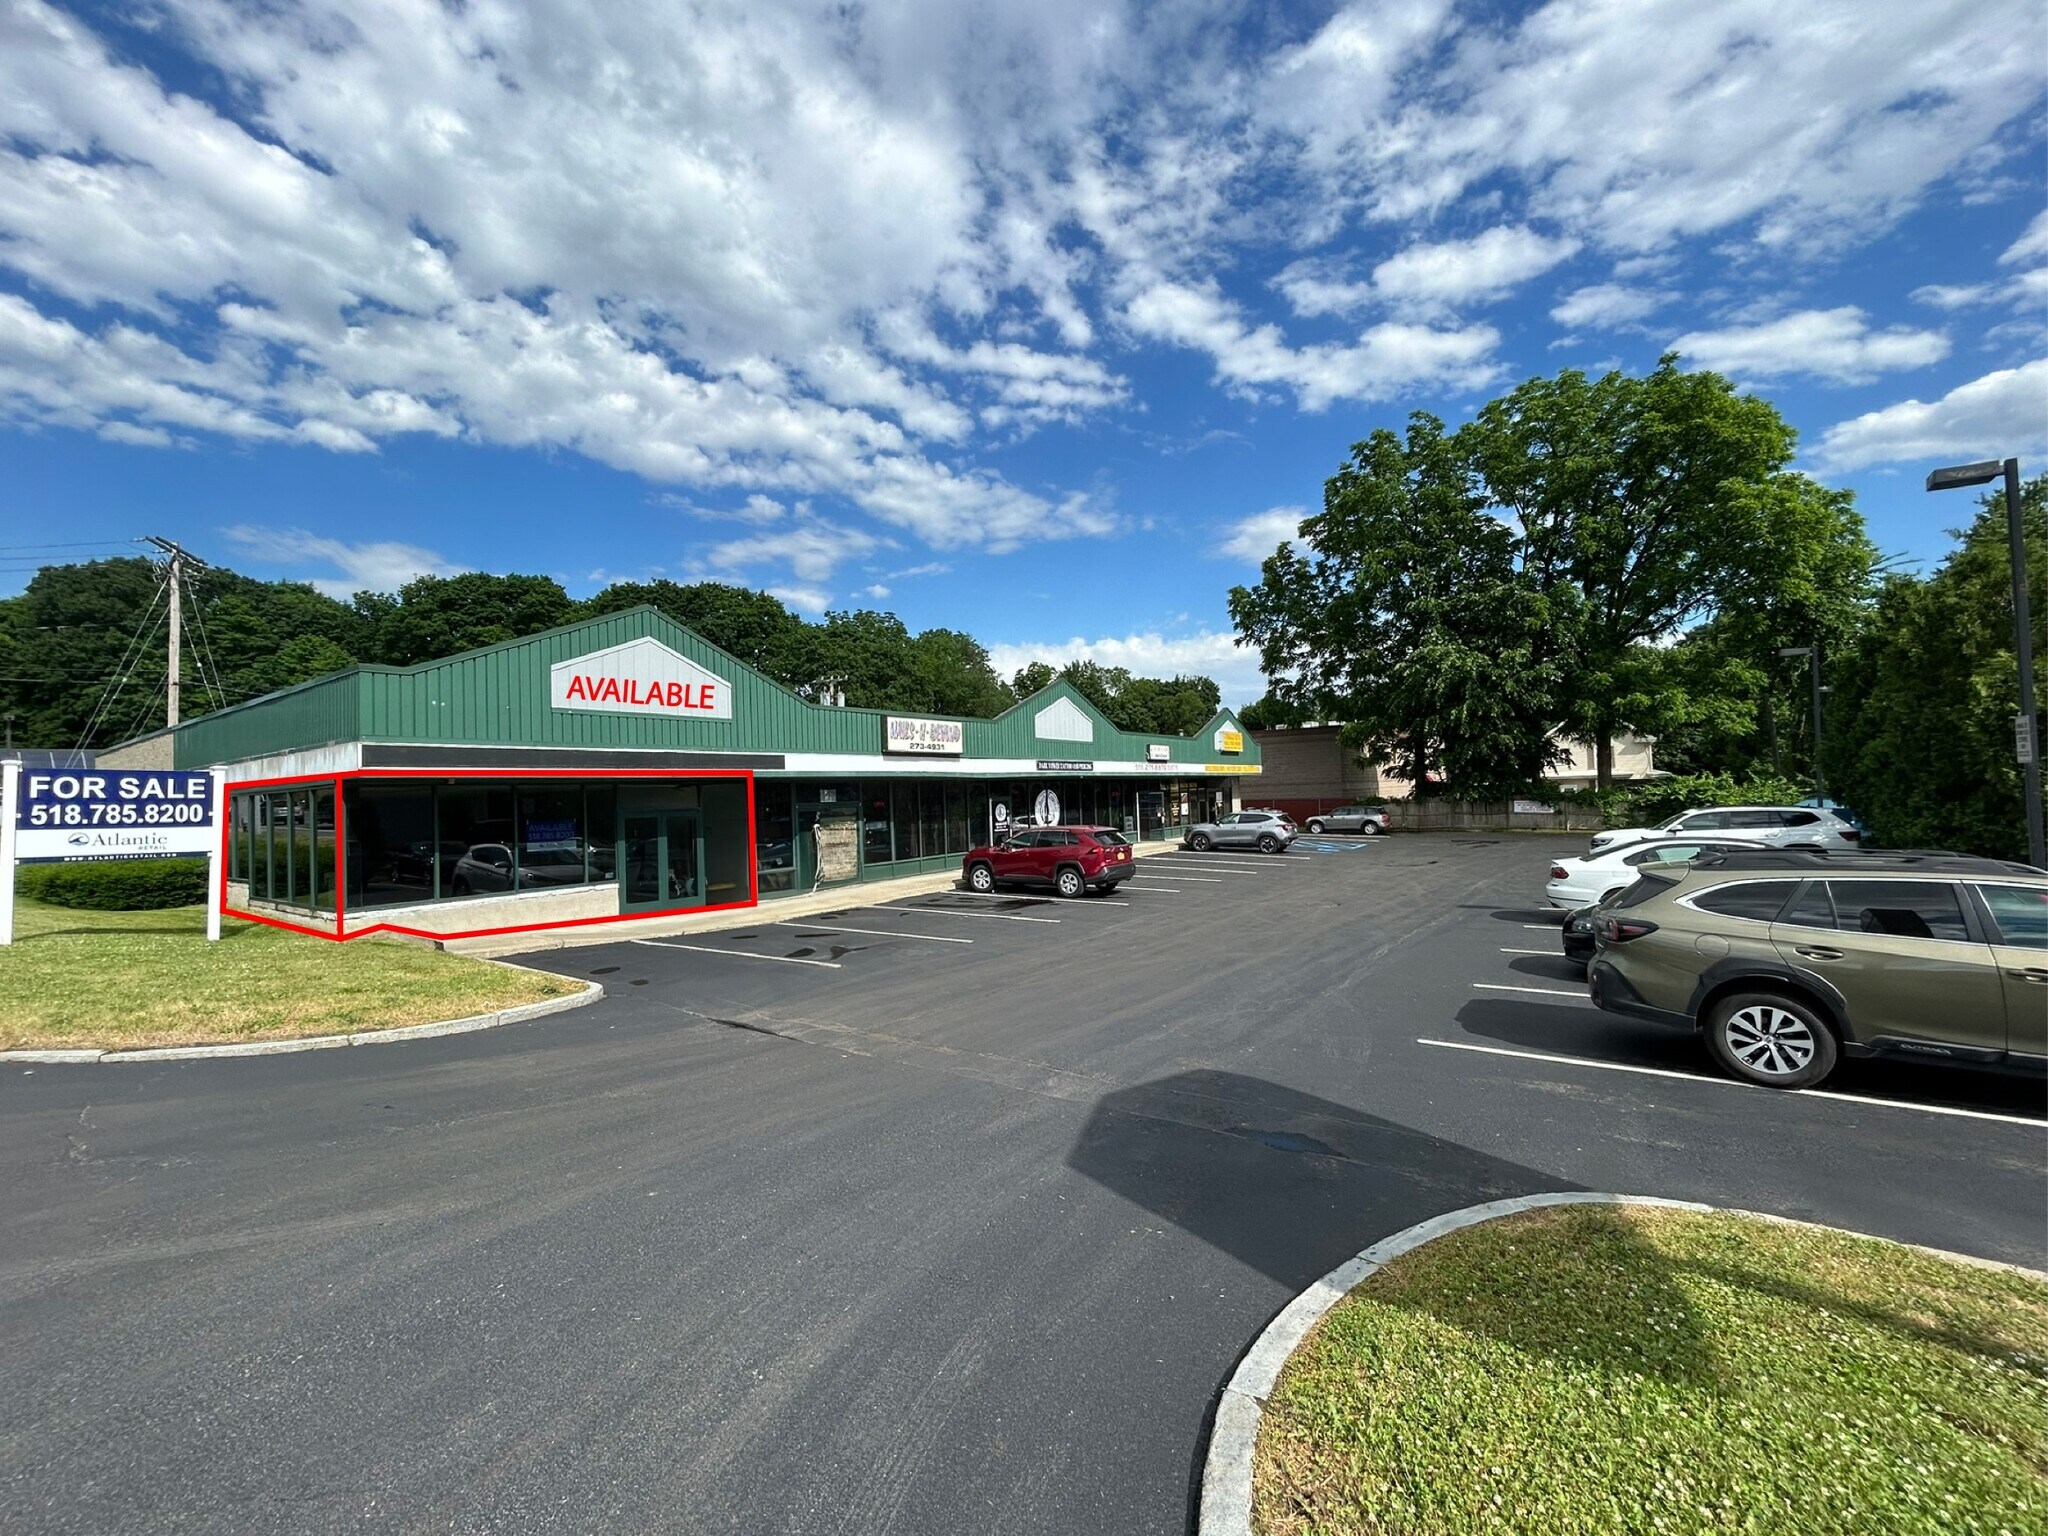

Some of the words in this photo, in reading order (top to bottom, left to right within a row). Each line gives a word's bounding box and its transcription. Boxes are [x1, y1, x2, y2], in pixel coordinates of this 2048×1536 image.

[29, 776, 106, 799] FOR
[118, 778, 206, 799] SALE
[30, 804, 204, 825] 518.785.8200
[529, 823, 574, 832] AVAILABLE
[92, 832, 168, 847] Atlantic
